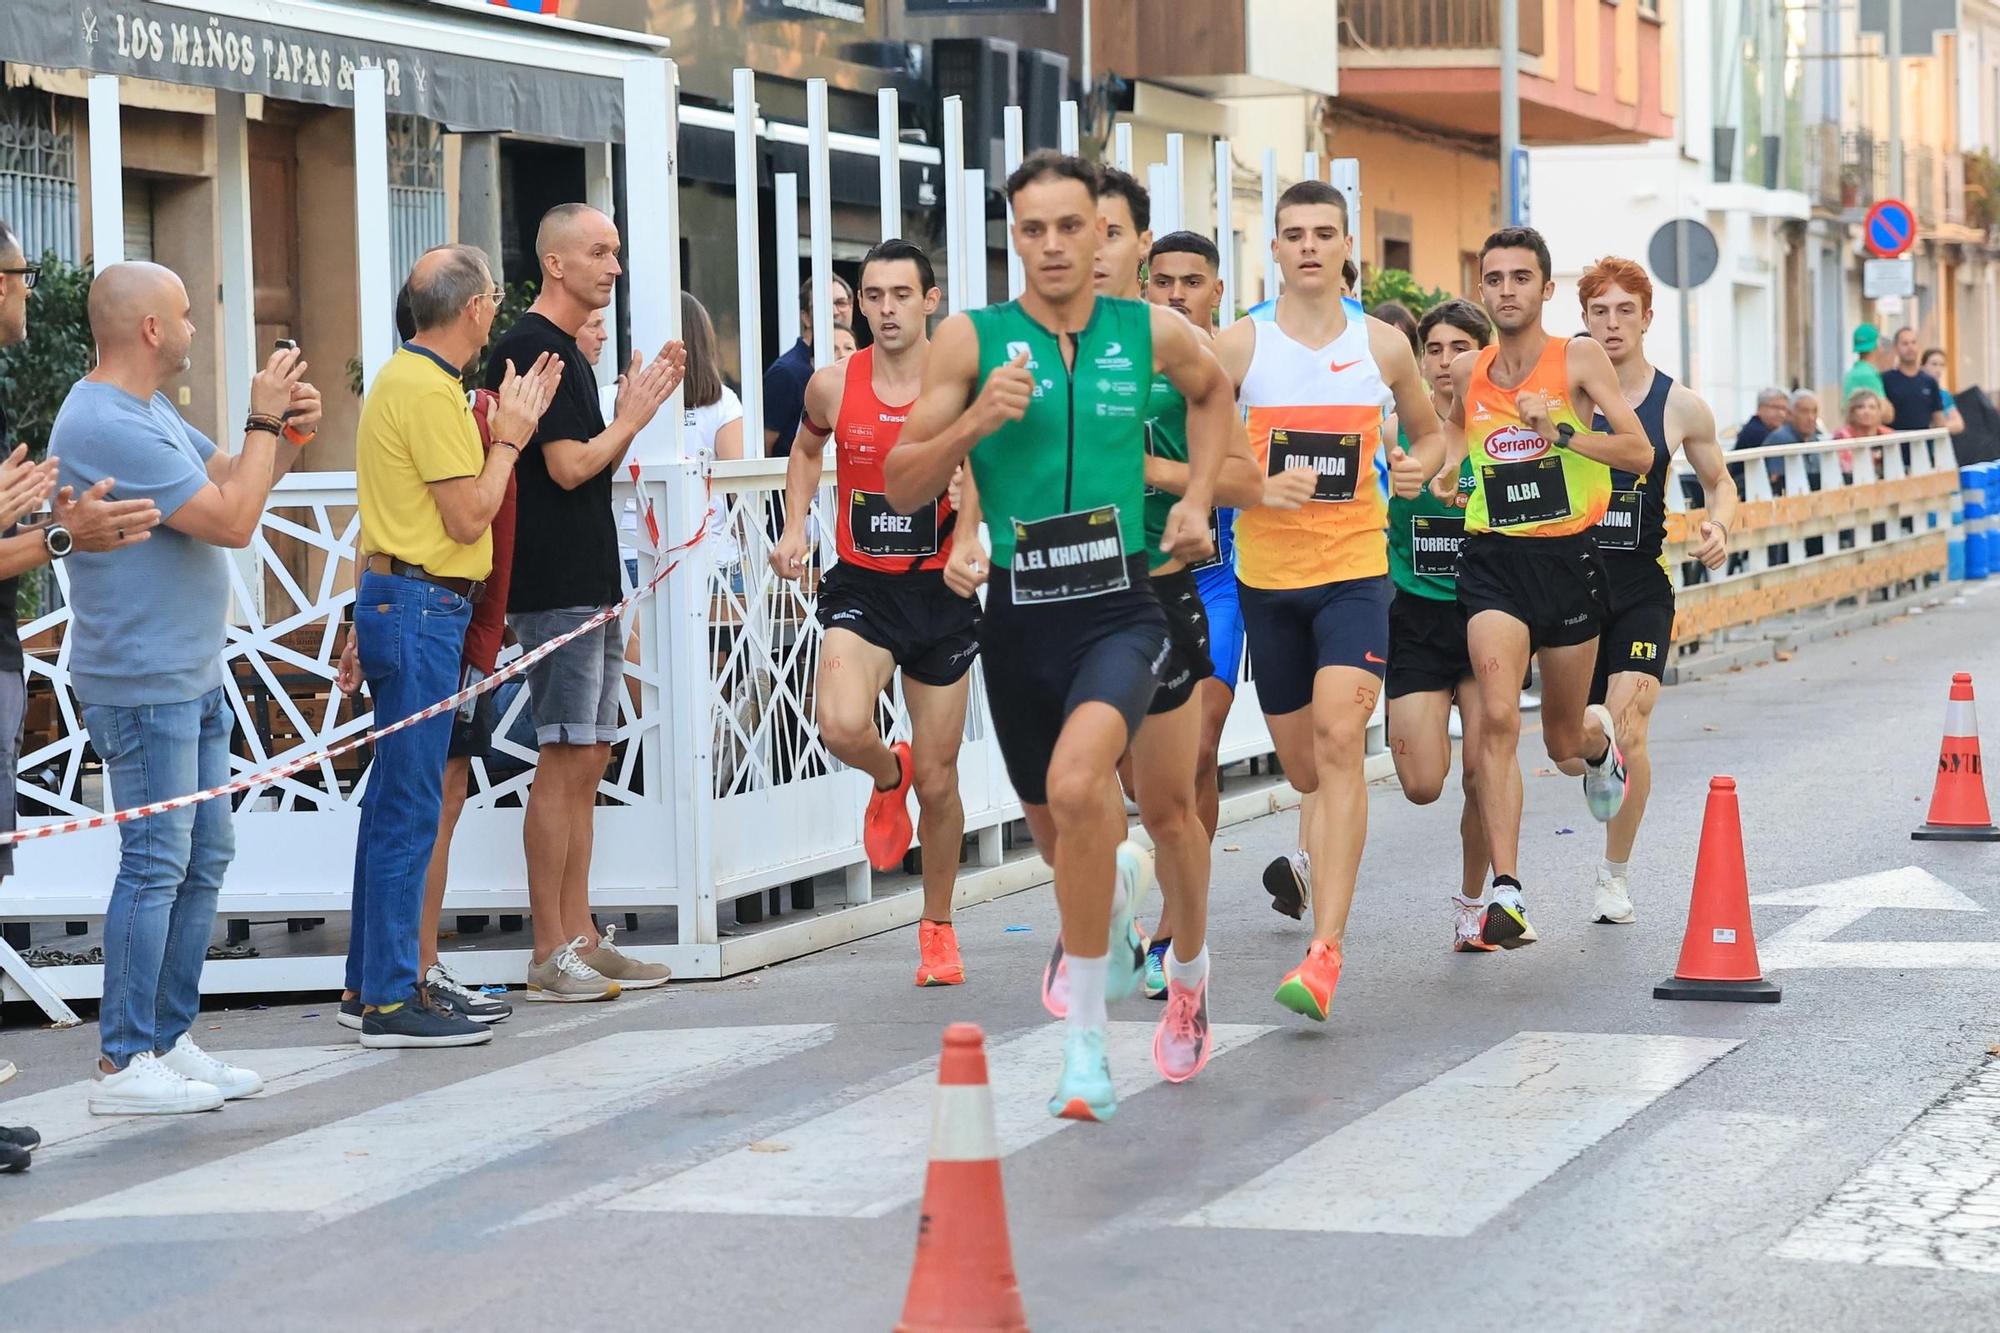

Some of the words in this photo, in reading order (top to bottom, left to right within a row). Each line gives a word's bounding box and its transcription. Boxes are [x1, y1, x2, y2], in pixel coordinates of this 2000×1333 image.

[116, 14, 163, 62] LOS
[171, 17, 256, 76] MAÑOS
[262, 38, 331, 88] TAPAS
[1490, 437, 1545, 454] Serrano
[1506, 481, 1541, 503] ALBA
[870, 511, 912, 533] PÉREZ
[1048, 536, 1120, 568] KHAYAMI
[1636, 678, 1650, 693] 49
[1354, 686, 1376, 711] 53
